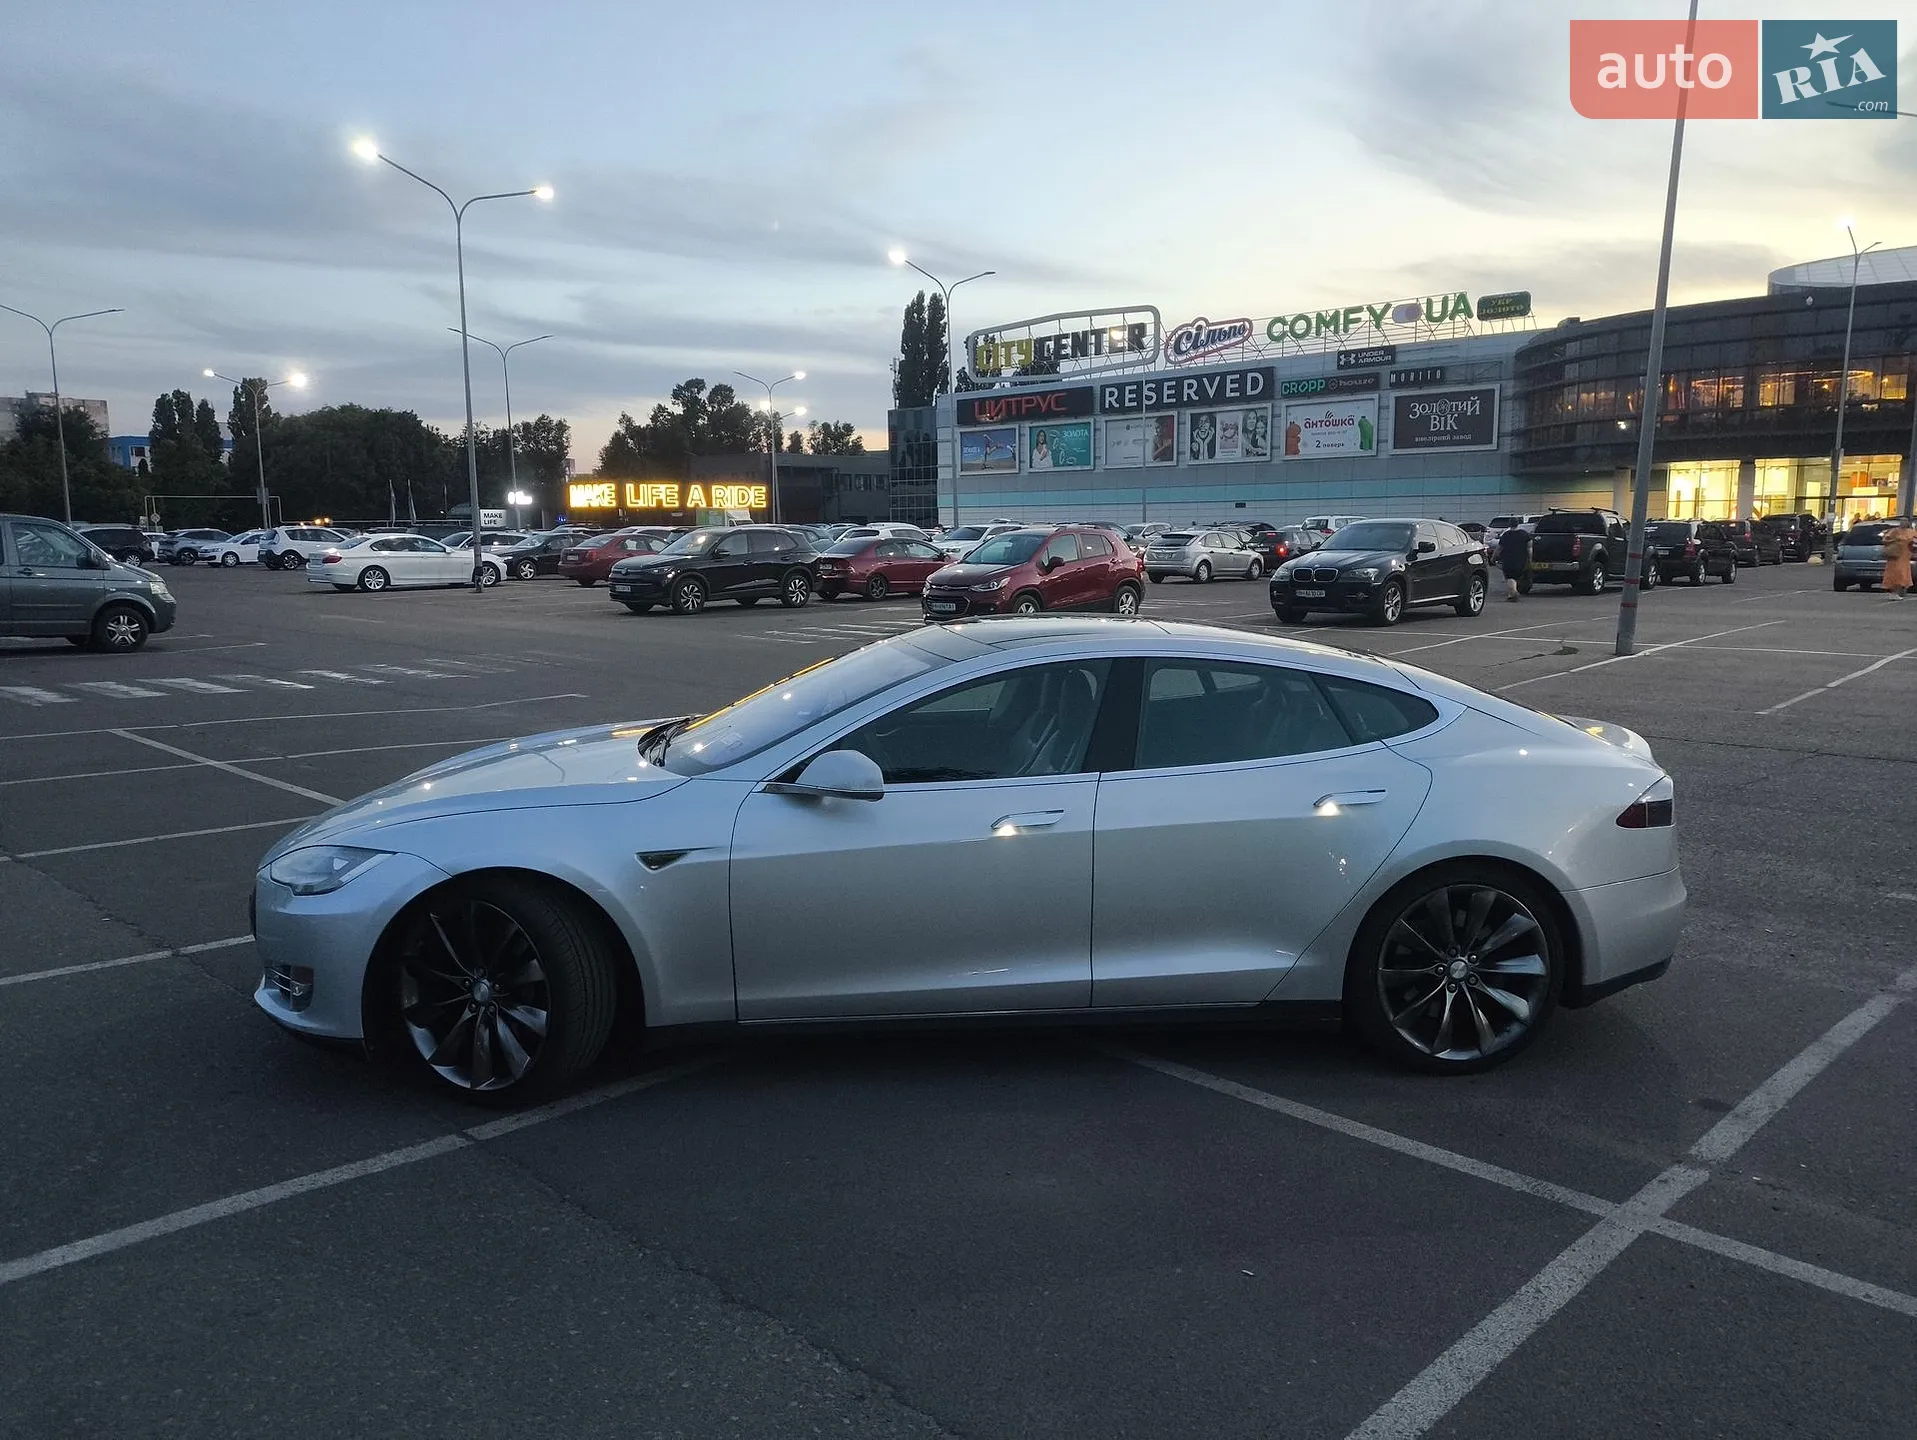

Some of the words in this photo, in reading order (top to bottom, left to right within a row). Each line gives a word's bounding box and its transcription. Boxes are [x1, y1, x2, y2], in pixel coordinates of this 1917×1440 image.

[1266, 302, 1393, 343] COMFY
[1426, 292, 1475, 324] UA
[1357, 350, 1385, 358] UNDER
[1358, 355, 1392, 364] ARMOUR
[1104, 371, 1264, 409] RESERVED
[1282, 379, 1327, 395] CROPP
[974, 393, 1068, 420] ЦИТРУС
[1315, 440, 1322, 449] 2
[569, 484, 616, 508] MAKE
[625, 483, 679, 508] LIFE
[687, 485, 706, 508] A
[711, 485, 767, 509] RIDE
